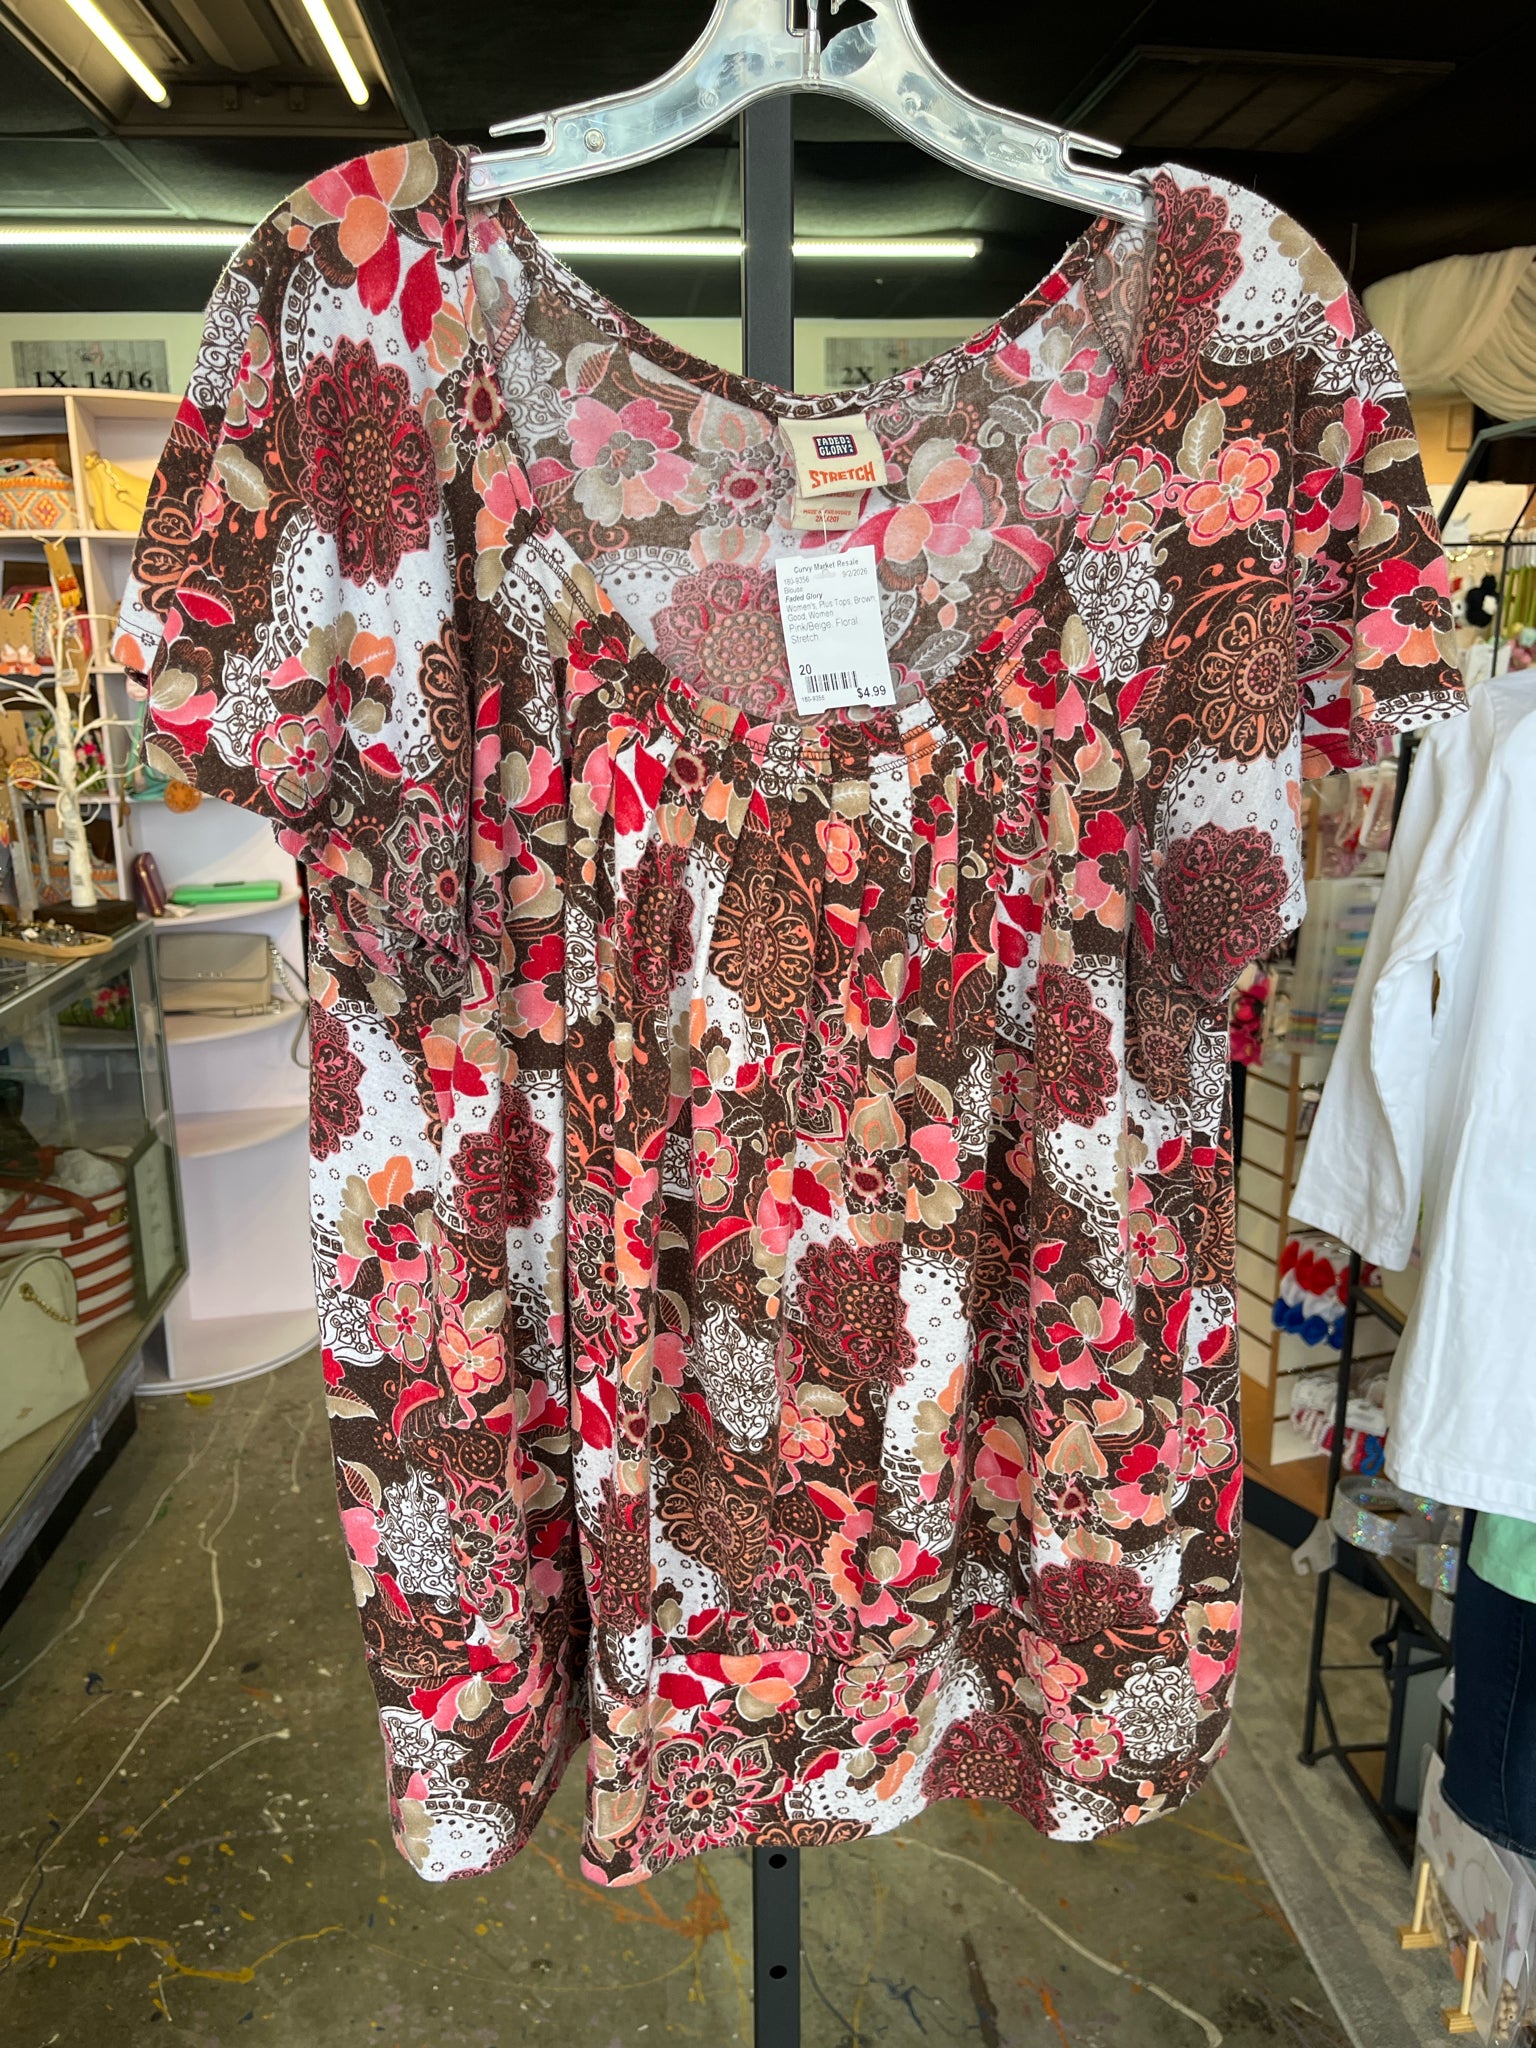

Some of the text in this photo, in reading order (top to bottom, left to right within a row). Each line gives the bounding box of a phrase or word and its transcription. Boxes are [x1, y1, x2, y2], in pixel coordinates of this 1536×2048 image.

[86, 370, 153, 388] 14/16
[840, 366, 873, 385] 2X
[816, 437, 845, 447] FADED
[819, 444, 848, 456] GLORY
[808, 461, 876, 489] STRETCH
[793, 558, 859, 575] Curvy Market Resale
[785, 591, 823, 603] Faded Glory
[808, 609, 834, 619] Women
[791, 633, 819, 645] Stretch
[798, 663, 812, 676] 20
[856, 684, 887, 699] $4.99
